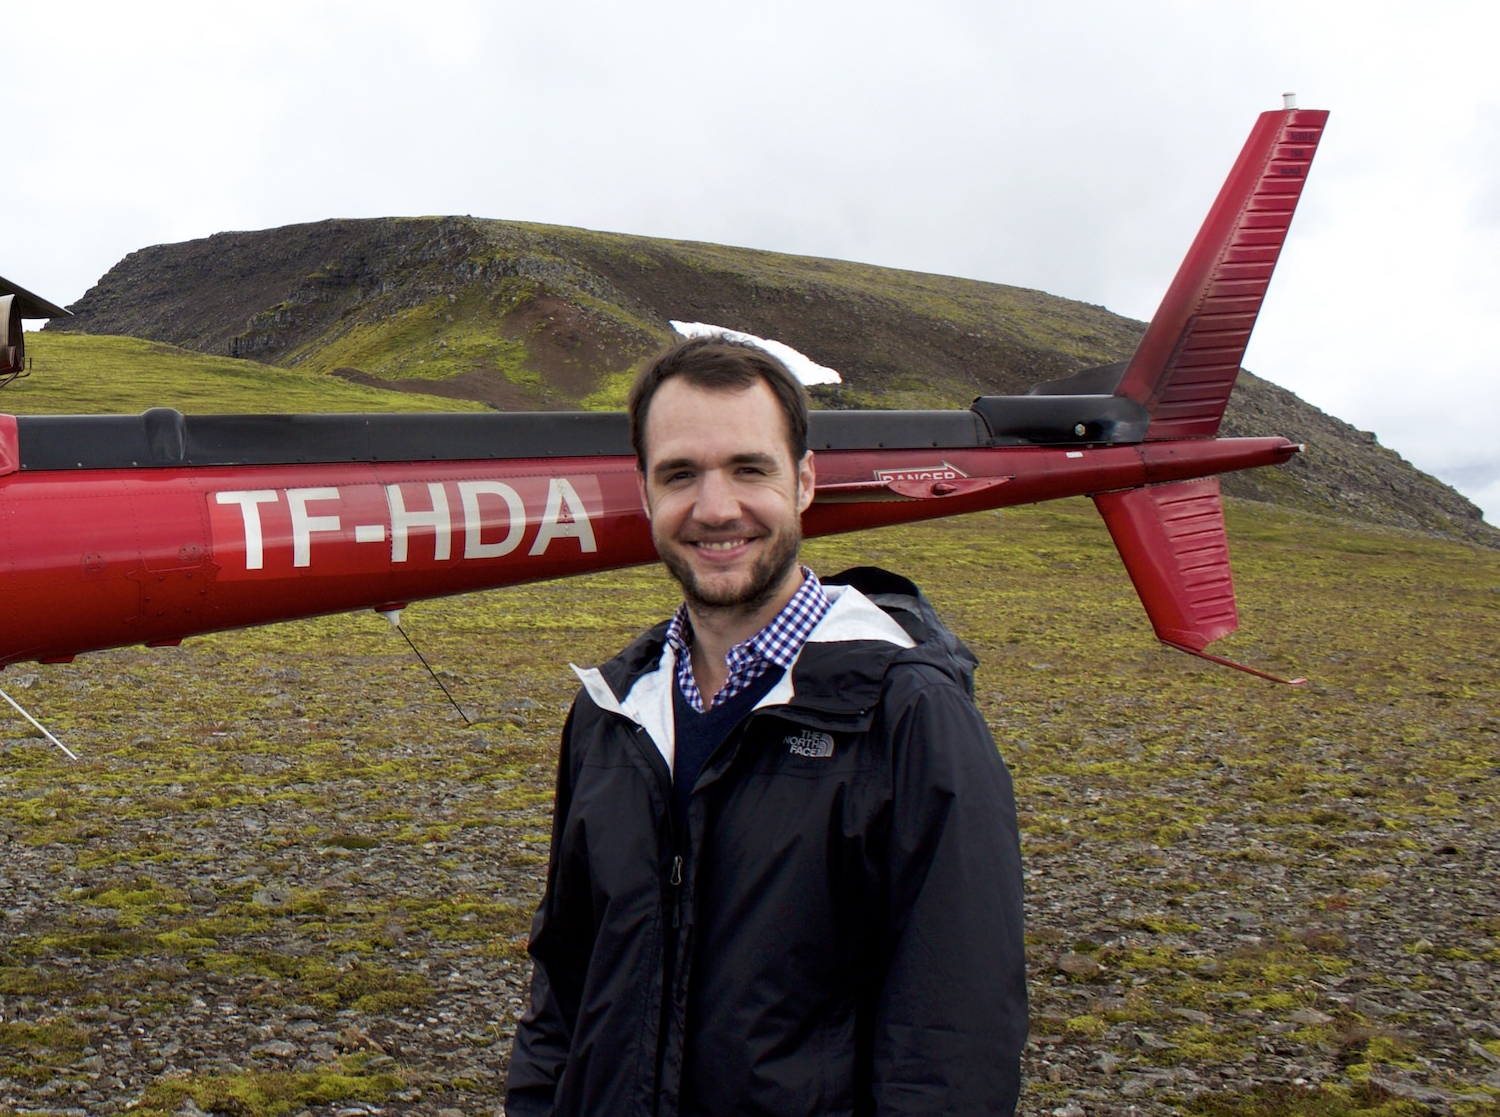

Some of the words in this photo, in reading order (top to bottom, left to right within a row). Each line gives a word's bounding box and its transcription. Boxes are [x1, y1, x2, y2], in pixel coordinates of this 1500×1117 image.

[215, 477, 598, 570] TF-HDA
[801, 729, 821, 741] THE
[783, 736, 821, 749] NORTH
[790, 745, 817, 757] FACE
